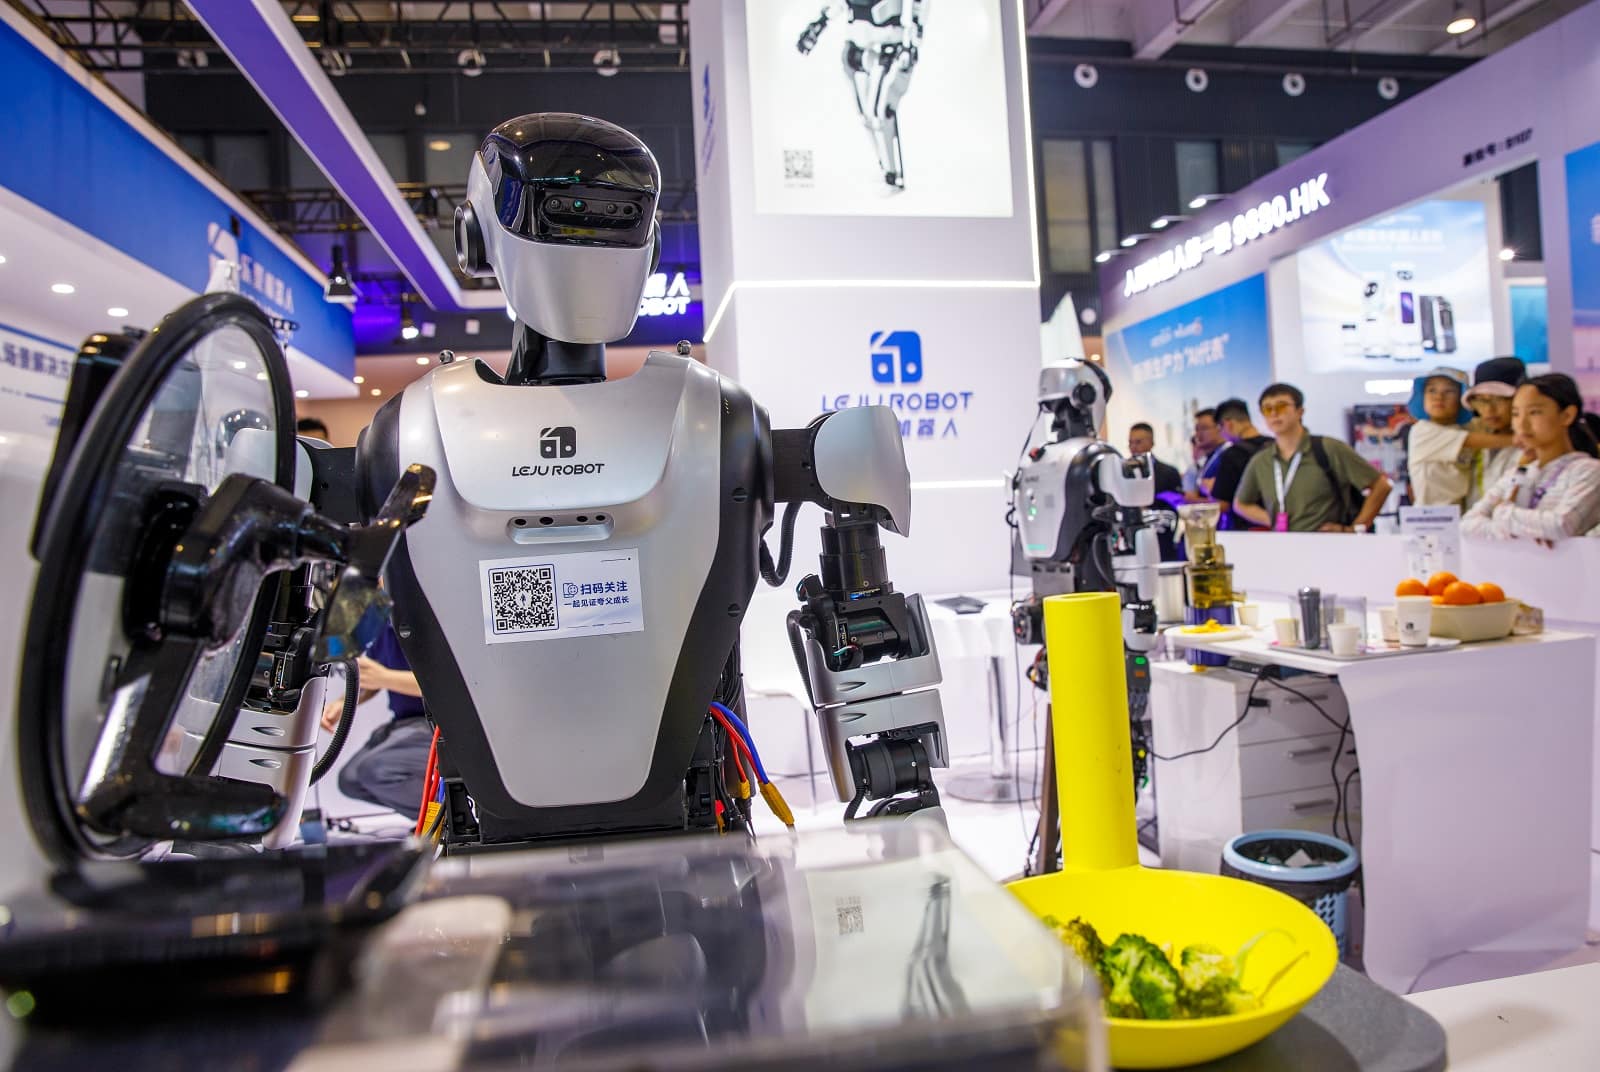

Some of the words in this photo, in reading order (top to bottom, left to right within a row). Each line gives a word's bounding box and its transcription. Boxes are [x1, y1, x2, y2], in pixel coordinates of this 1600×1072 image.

[638, 296, 691, 316] OBOT
[890, 391, 974, 411] ROBOT
[511, 465, 548, 477] LEJU
[551, 463, 605, 476] ROBOT
[580, 580, 628, 595] 扫码关注
[563, 595, 630, 608] 一起见证夸父成长
